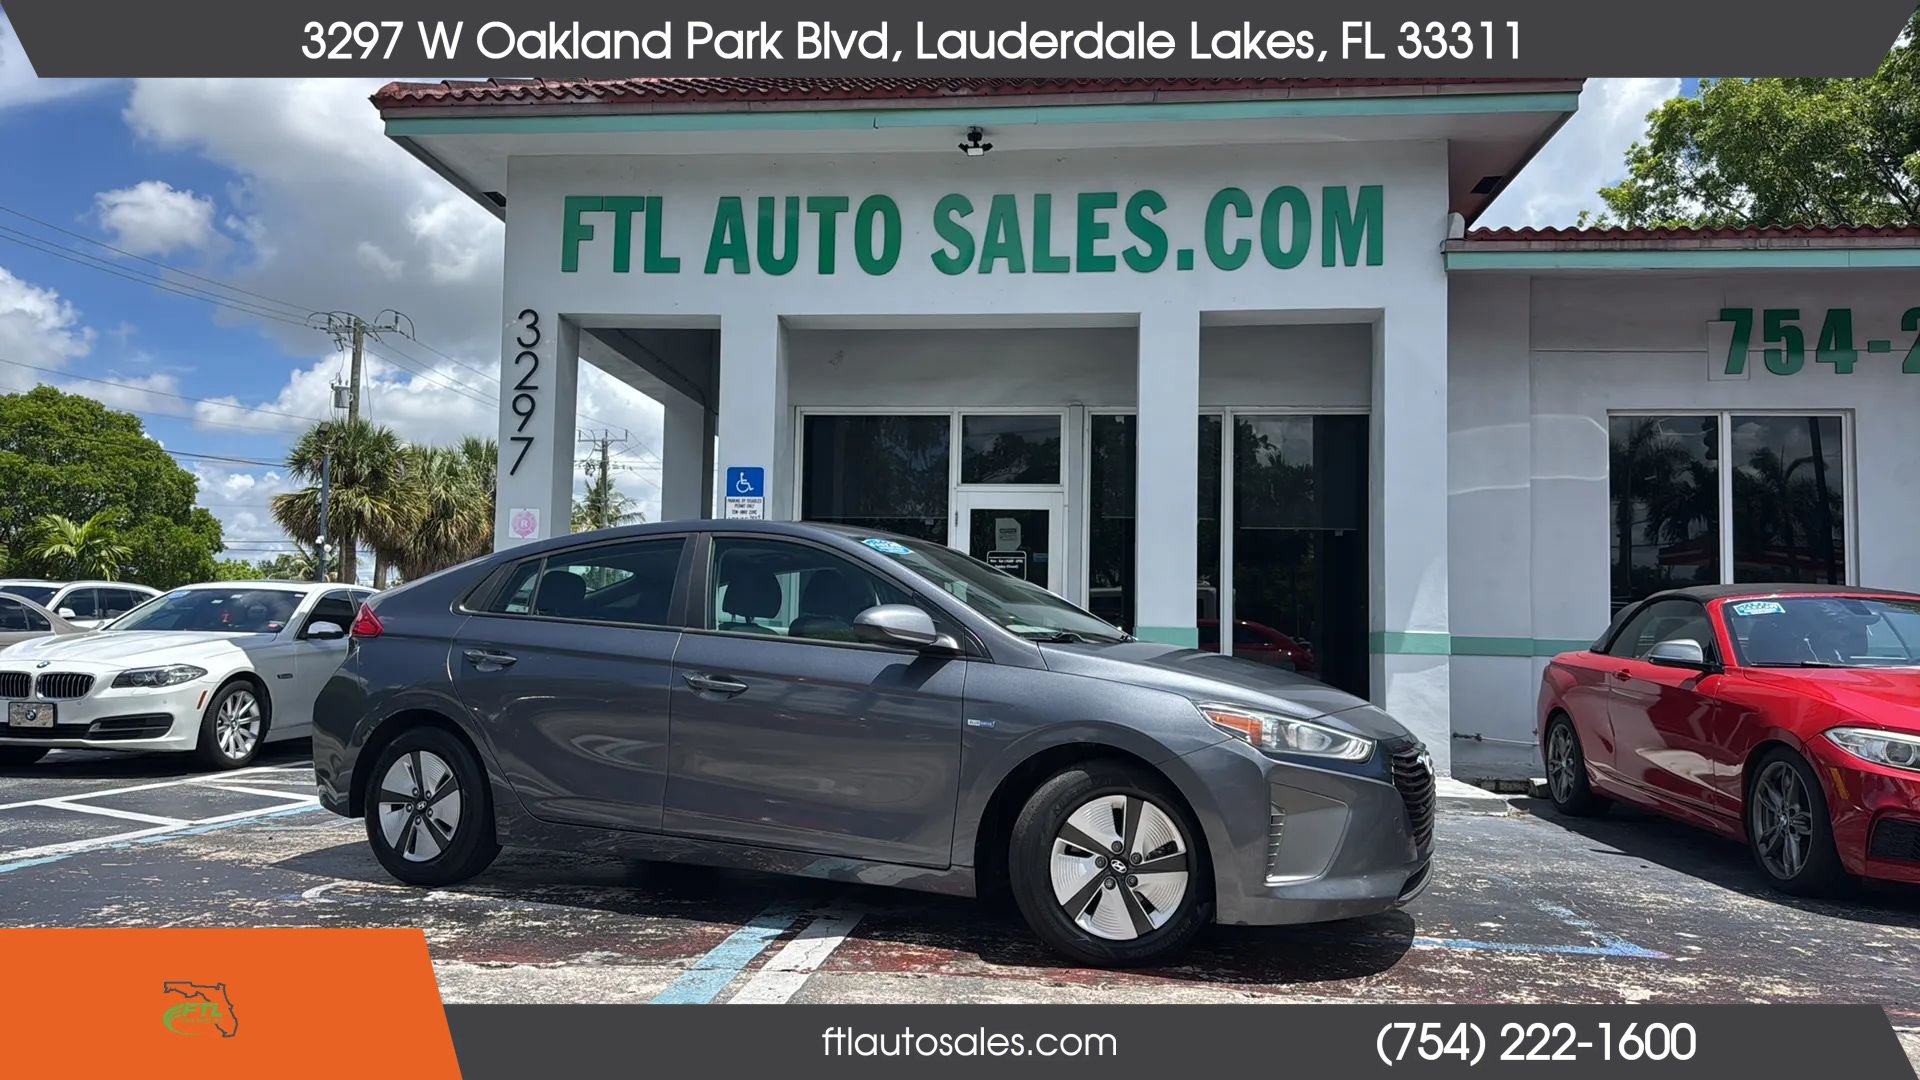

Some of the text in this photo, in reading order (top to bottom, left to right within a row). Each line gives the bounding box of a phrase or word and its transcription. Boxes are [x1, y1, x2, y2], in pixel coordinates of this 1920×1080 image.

[562, 185, 1385, 277] FTL AUTO SALES.COM
[510, 308, 541, 476] 3297
